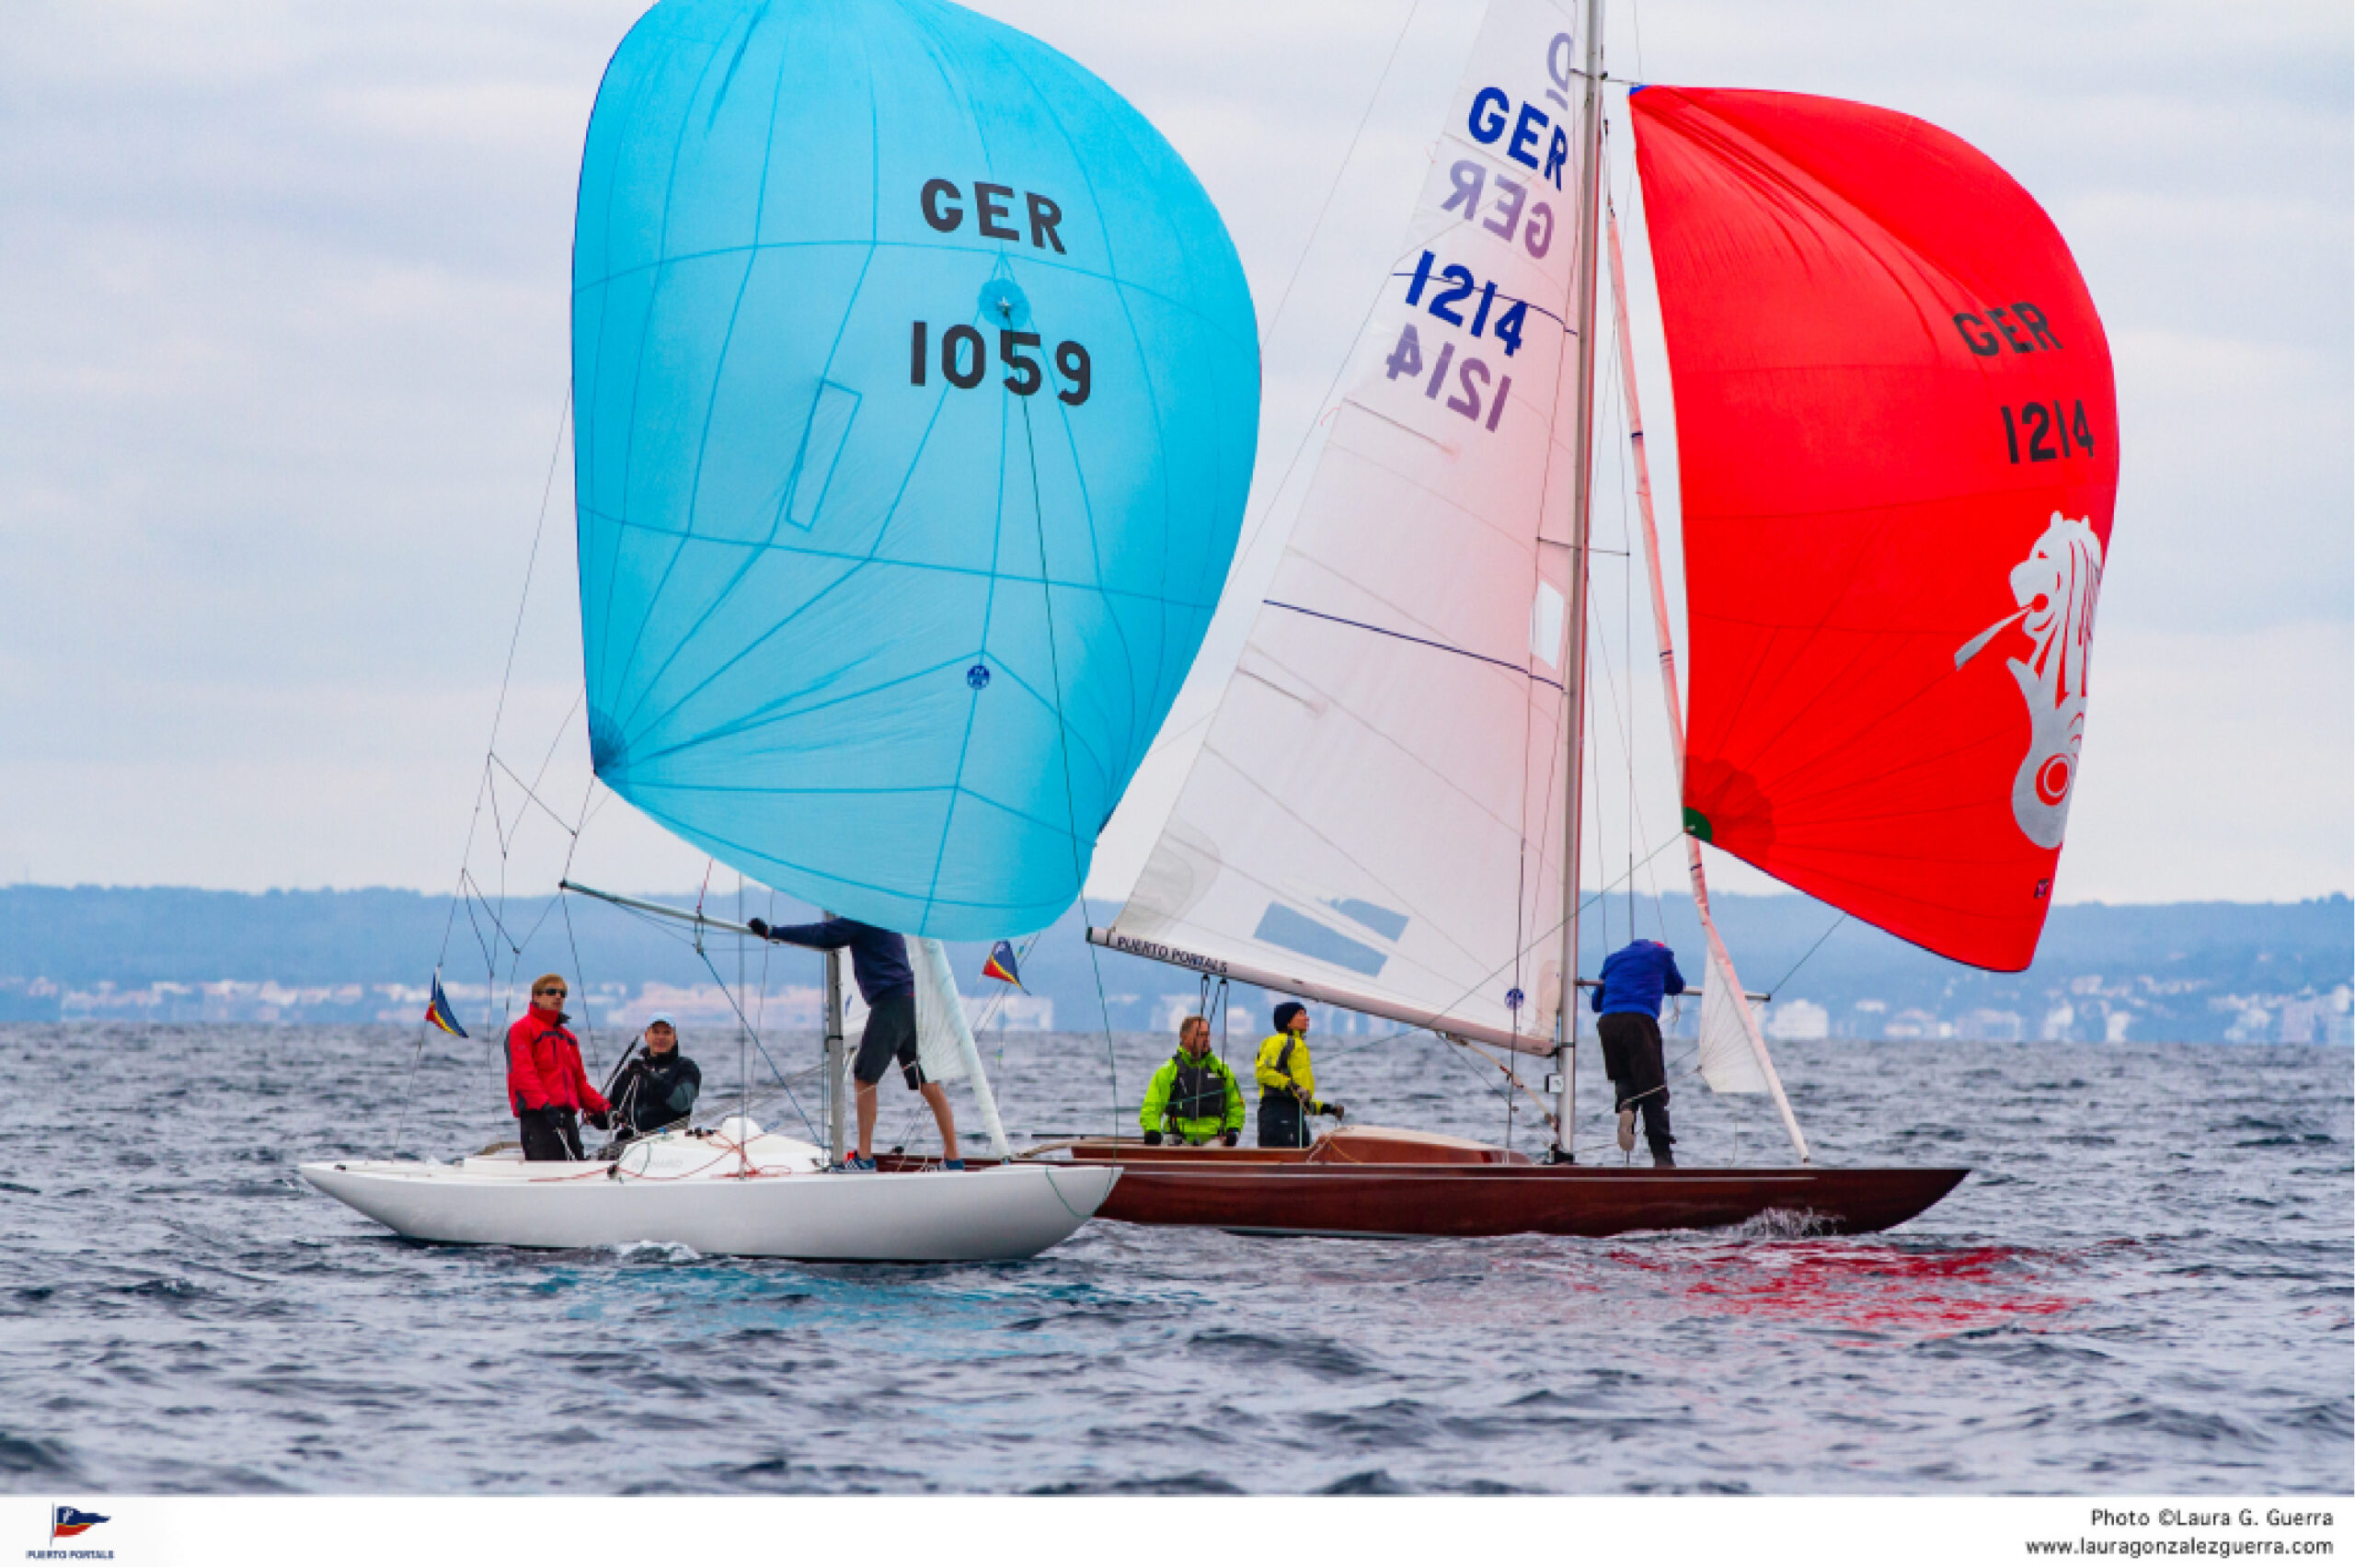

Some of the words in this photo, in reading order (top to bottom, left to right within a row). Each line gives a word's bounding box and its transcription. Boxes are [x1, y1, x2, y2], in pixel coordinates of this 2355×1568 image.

[1468, 86, 1568, 190] GER
[920, 177, 1067, 255] GER
[1406, 249, 1529, 357] 1214
[1952, 301, 2063, 356] GER
[910, 320, 1091, 406] 1059
[2000, 399, 2095, 464] 1214
